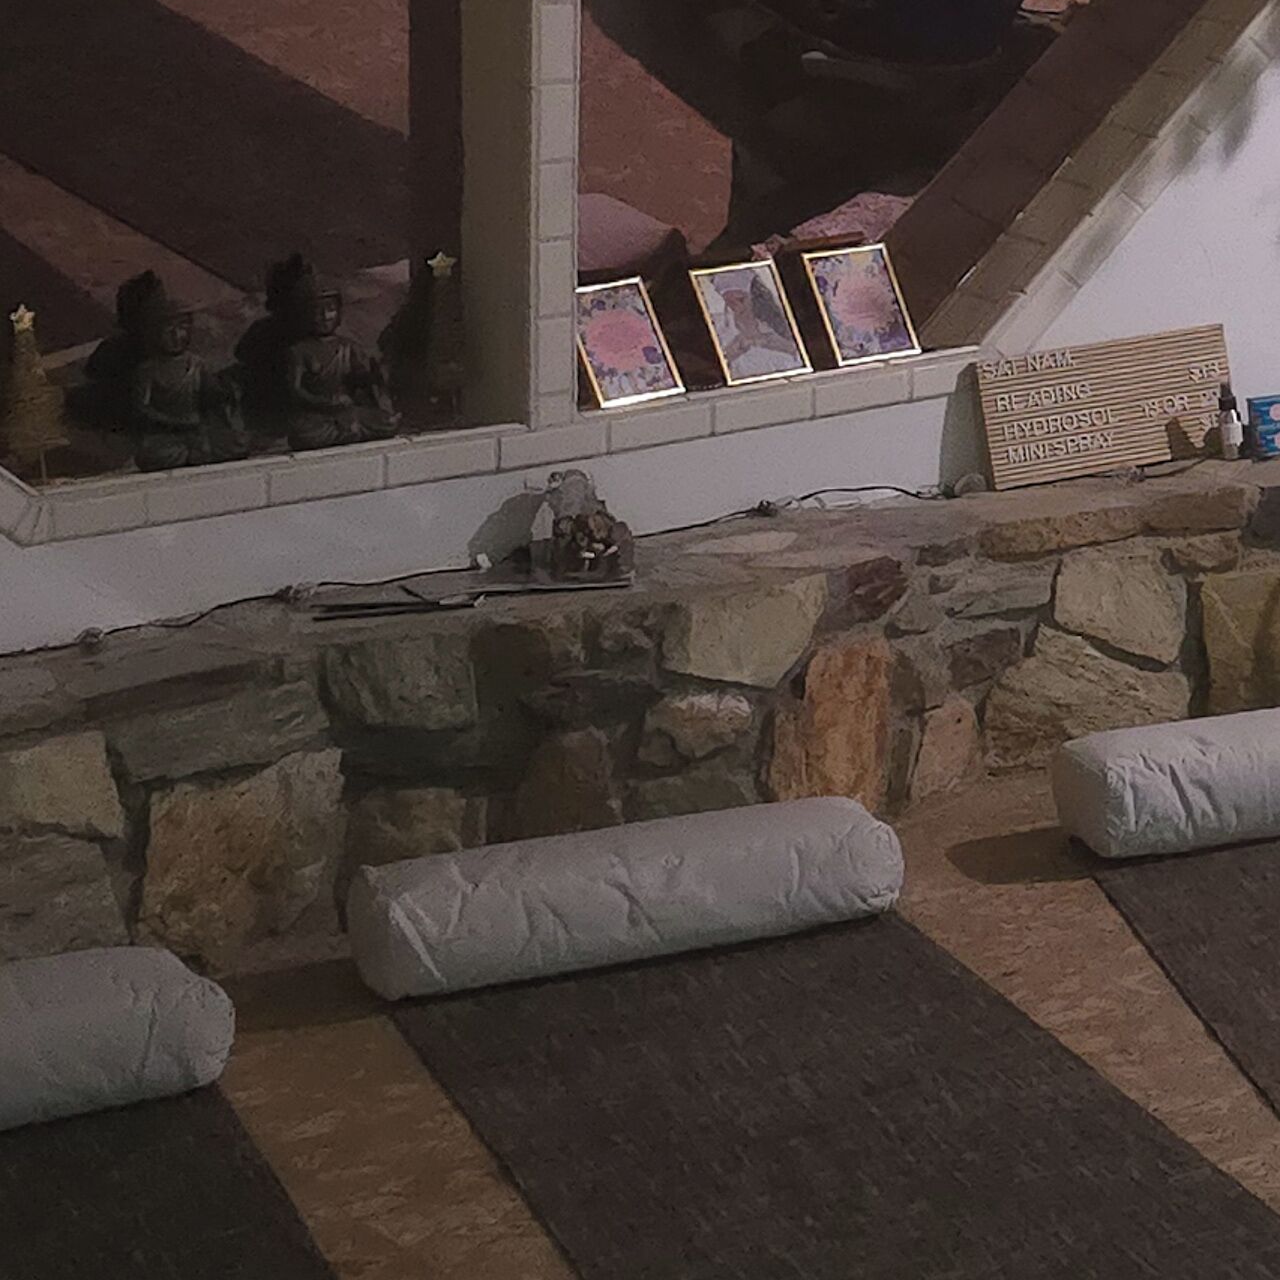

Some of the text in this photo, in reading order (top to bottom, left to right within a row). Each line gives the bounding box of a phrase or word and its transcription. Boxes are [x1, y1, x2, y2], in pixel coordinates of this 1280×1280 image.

[982, 349, 1076, 380] SAT NAM
[995, 383, 1091, 412] READING
[1003, 407, 1119, 441] HYDROSOL
